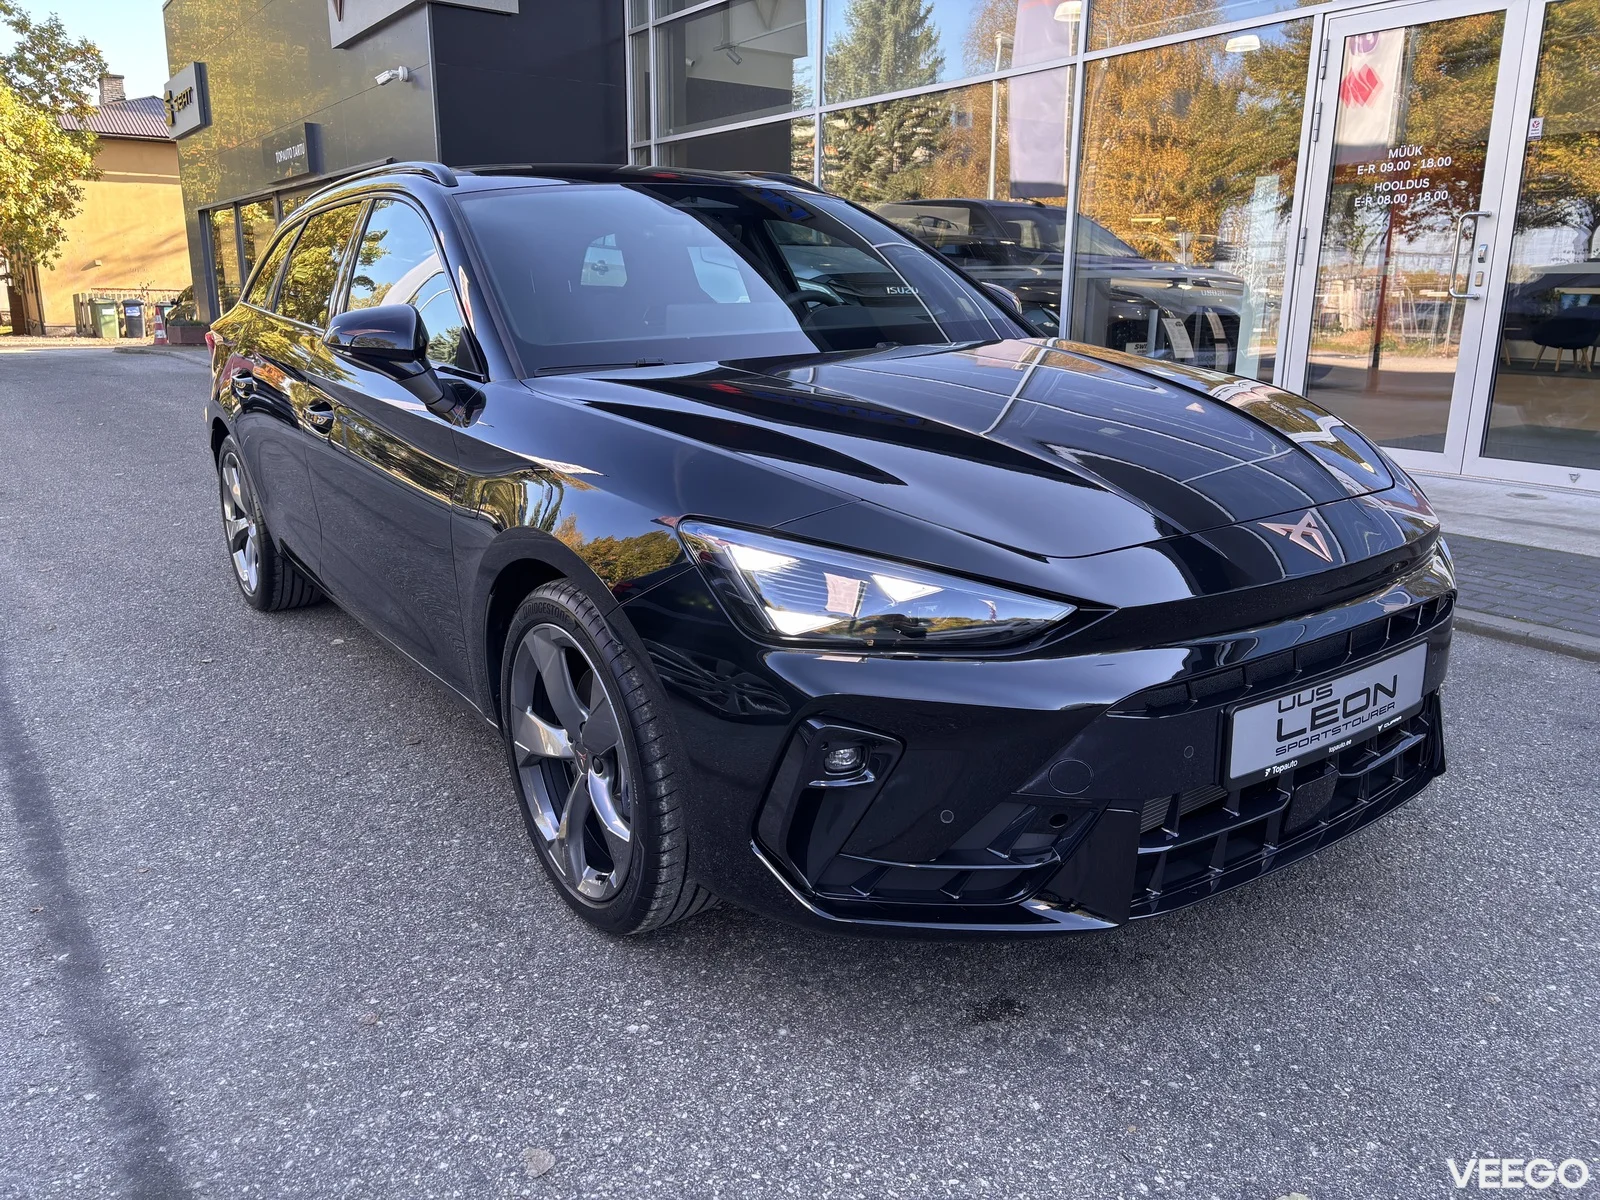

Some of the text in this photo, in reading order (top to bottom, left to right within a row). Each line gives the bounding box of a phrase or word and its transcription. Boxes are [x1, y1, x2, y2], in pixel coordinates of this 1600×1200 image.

[173, 86, 193, 112] SEAT
[1388, 145, 1423, 159] MÜÜK
[1357, 164, 1376, 175] E-R
[1380, 160, 1411, 173] 09.00
[1420, 156, 1452, 169] 18.00
[1374, 178, 1430, 193] HOOLDUS
[1354, 196, 1373, 207] E-R
[1377, 193, 1408, 206] 08.00
[1417, 190, 1449, 202] 18.00
[886, 286, 919, 295] ISUZU
[523, 601, 570, 623] BRIDGESTONE
[1277, 683, 1333, 714] UUS
[1276, 674, 1398, 743] LEON
[1275, 702, 1396, 757] SPORTSTOURER
[1272, 760, 1298, 774] Topauto
